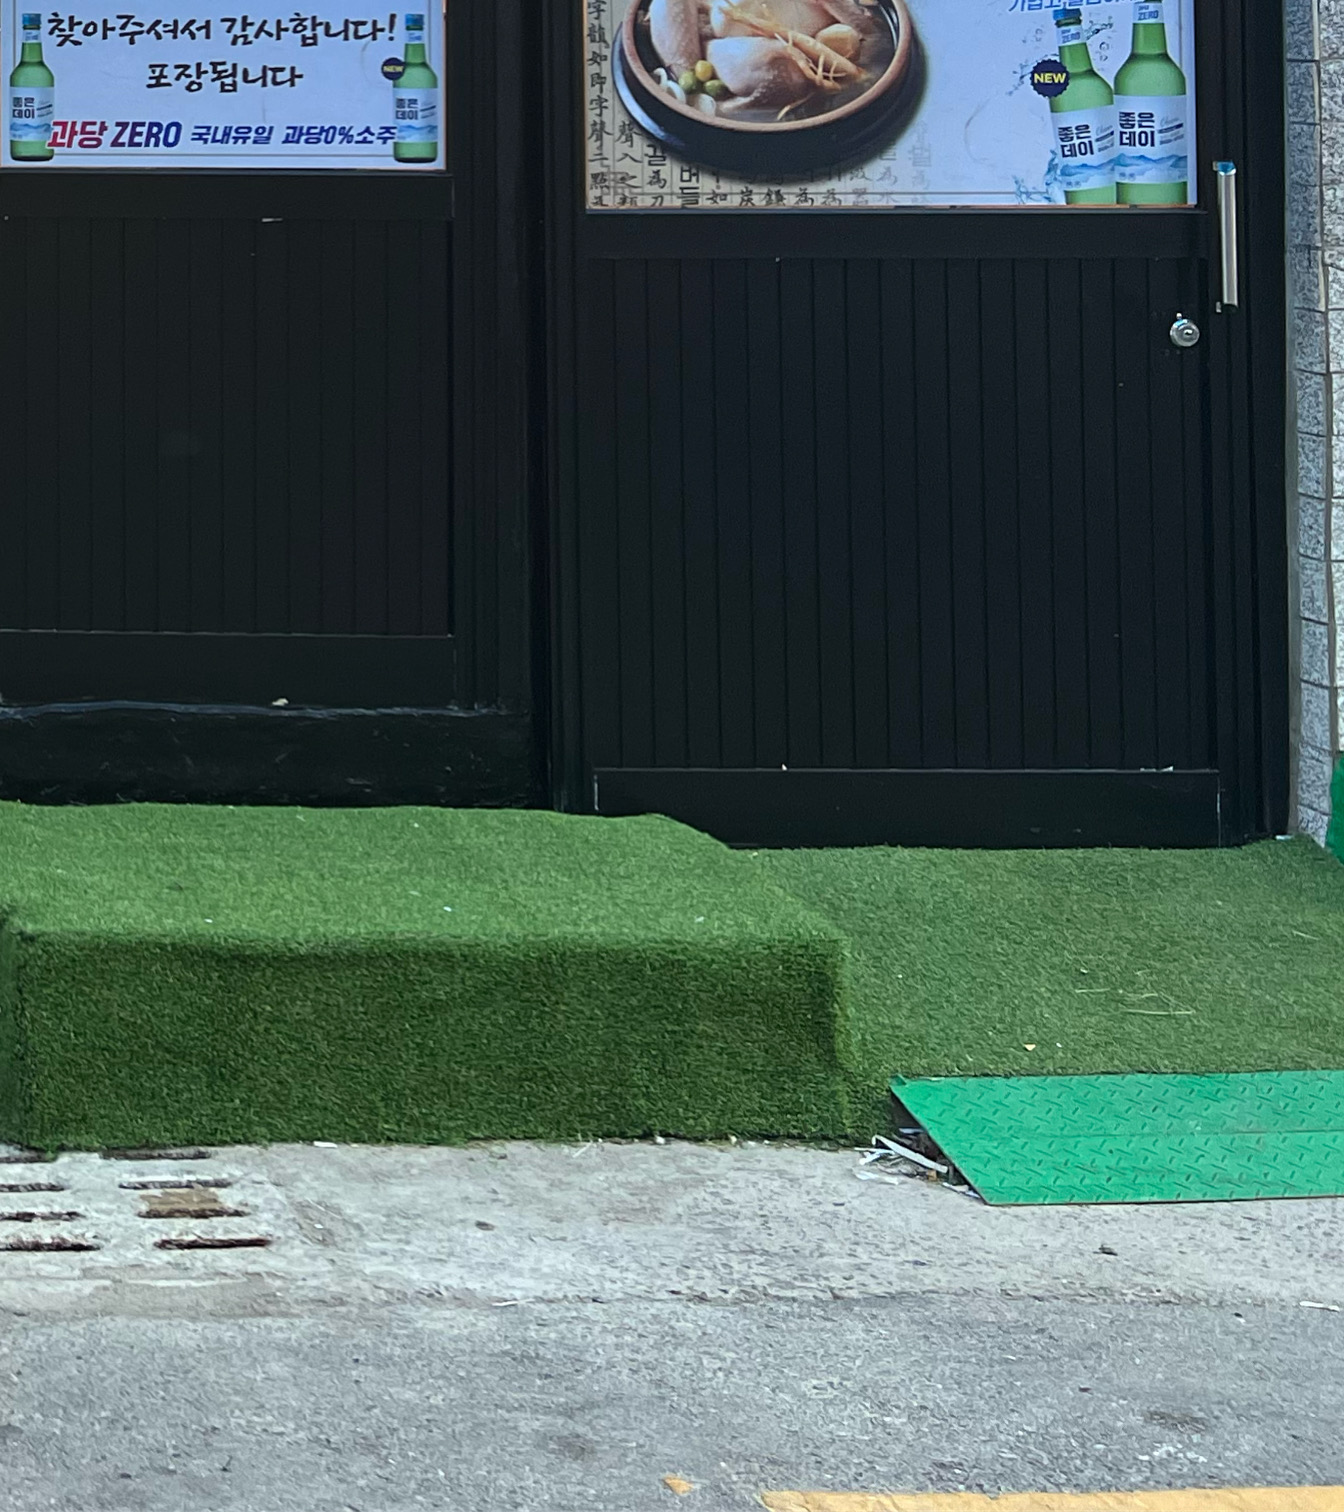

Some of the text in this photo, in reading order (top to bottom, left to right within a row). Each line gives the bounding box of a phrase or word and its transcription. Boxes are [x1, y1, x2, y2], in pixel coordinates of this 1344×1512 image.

[47, 12, 397, 47] 찾아주셔서 감사합니다!
[146, 61, 304, 93] 포장됩니다
[1033, 72, 1067, 84] NEW
[1118, 111, 1155, 130] 좋은
[47, 120, 398, 148] 과당 ZERO 국내유일 과당0%소주
[1058, 124, 1091, 143] 좋은
[1119, 130, 1156, 147] 데이
[1061, 140, 1095, 158] 데이
